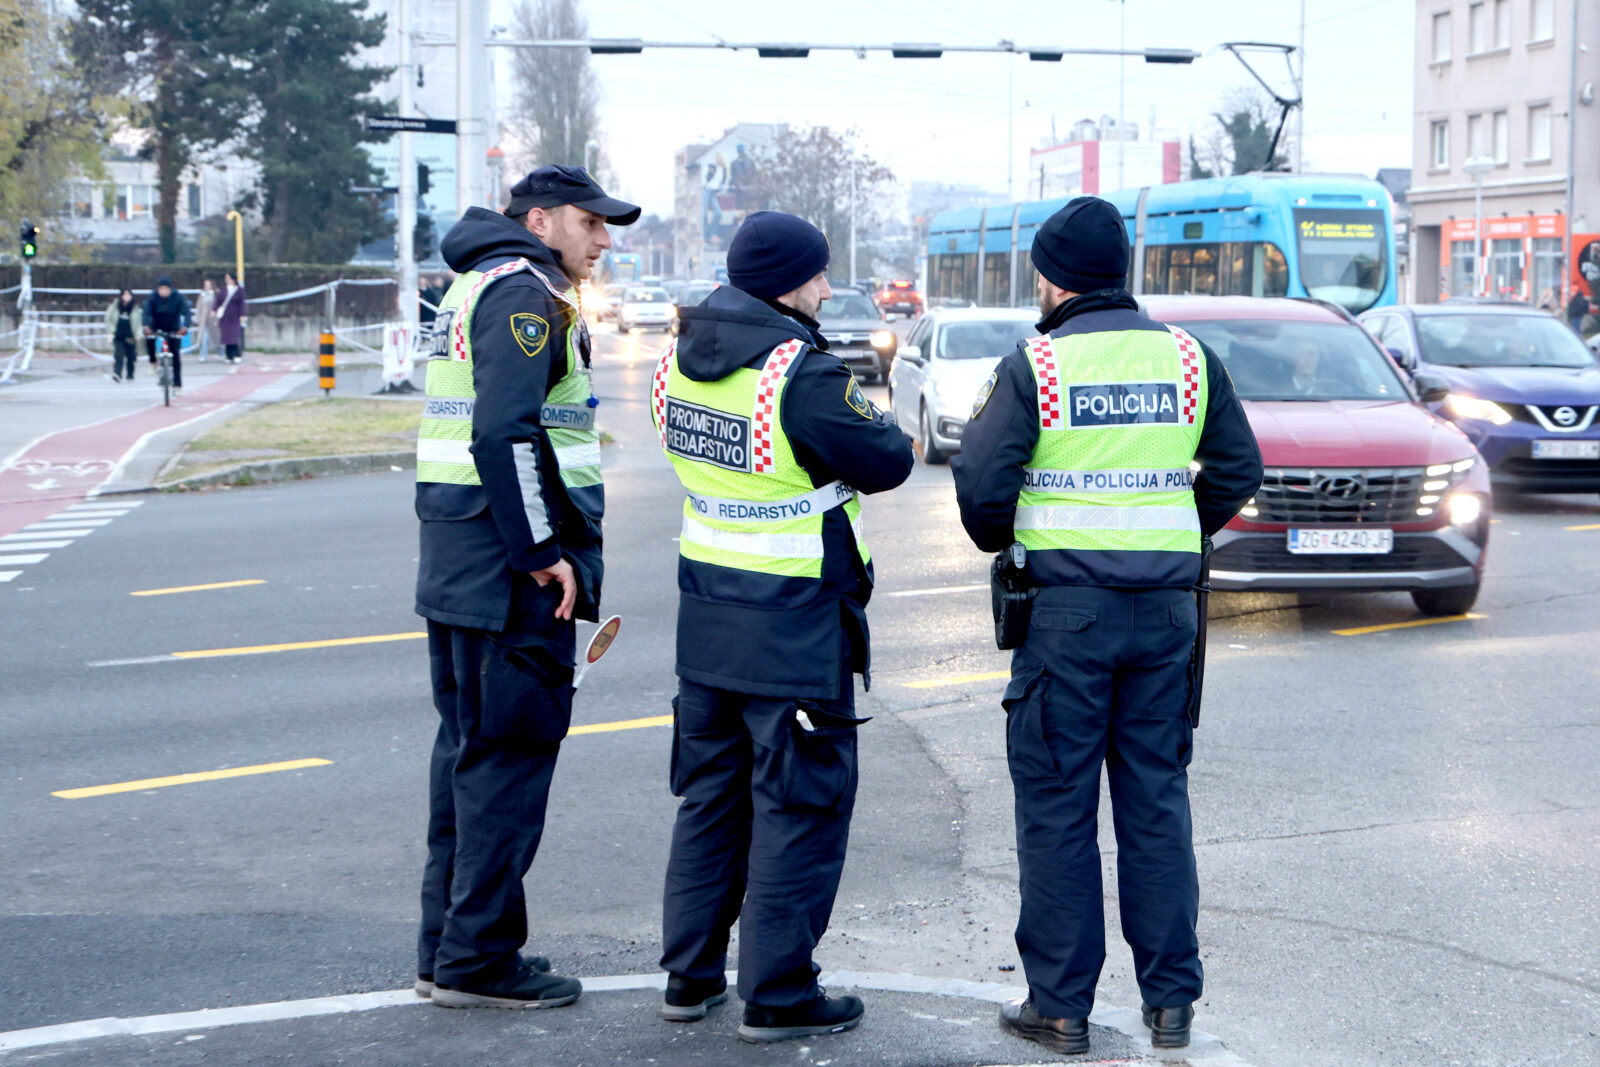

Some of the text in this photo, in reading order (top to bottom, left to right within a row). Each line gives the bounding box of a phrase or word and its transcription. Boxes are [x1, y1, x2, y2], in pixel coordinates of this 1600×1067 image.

[1075, 393, 1174, 417] POLICIJA
[669, 405, 742, 442] PROMETNO
[667, 427, 745, 465] REDARSTVO
[1083, 473, 1159, 489] POLICIJA
[718, 499, 812, 519] REDARSTVO
[1301, 531, 1320, 548] ZG
